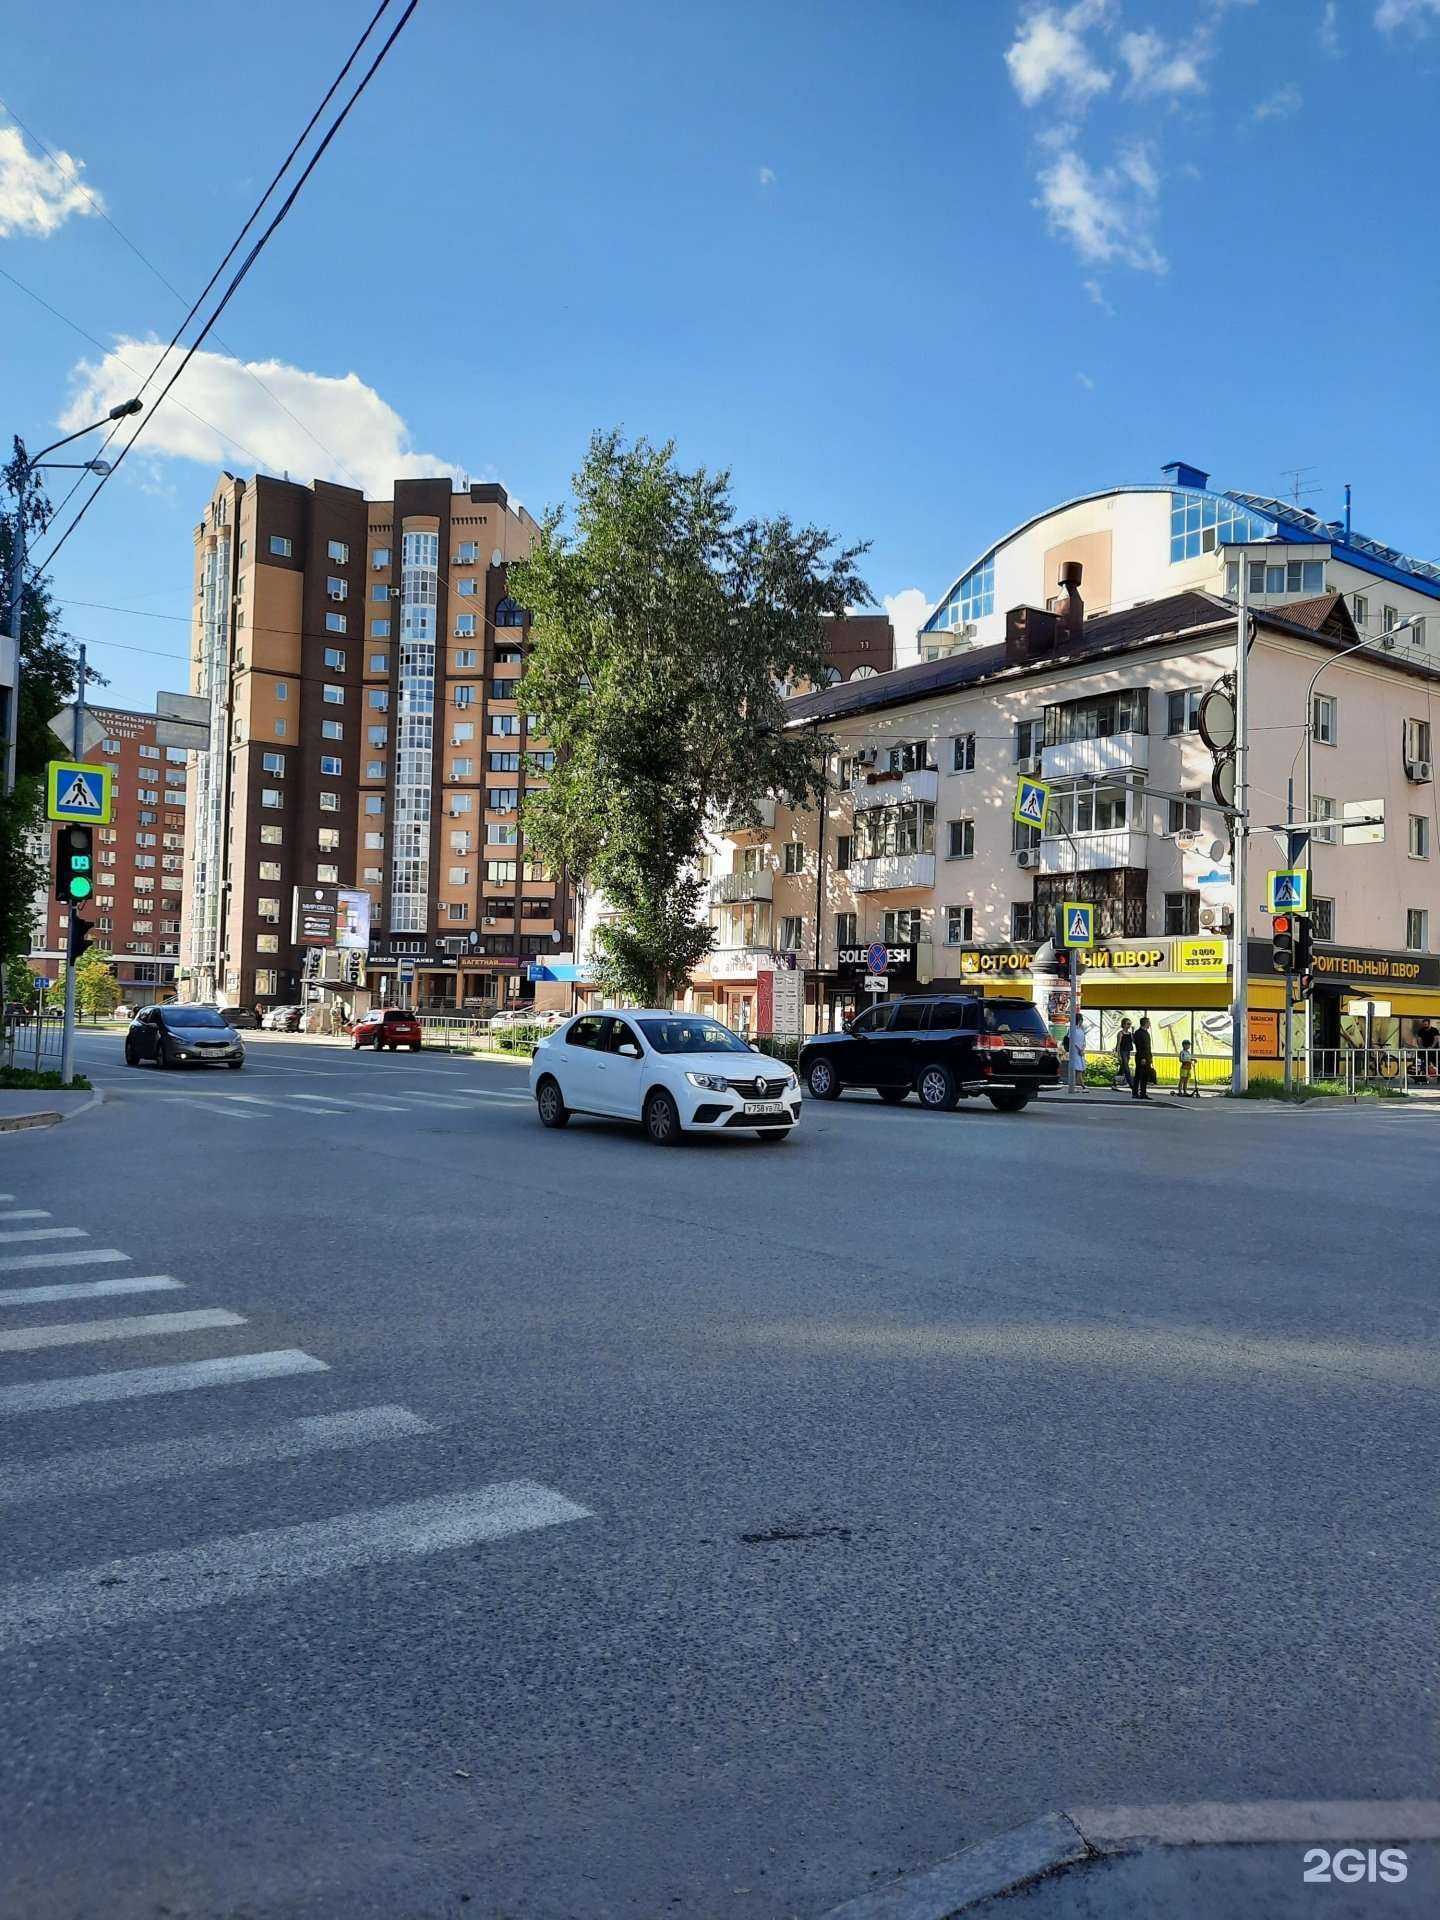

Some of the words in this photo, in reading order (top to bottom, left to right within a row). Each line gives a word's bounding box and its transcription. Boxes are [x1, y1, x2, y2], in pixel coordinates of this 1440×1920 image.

[1113, 950, 1163, 968] ДВОР
[1312, 954, 1389, 976] РОИТЕЛЬНЫЙ
[1391, 963, 1420, 978] ДВОР
